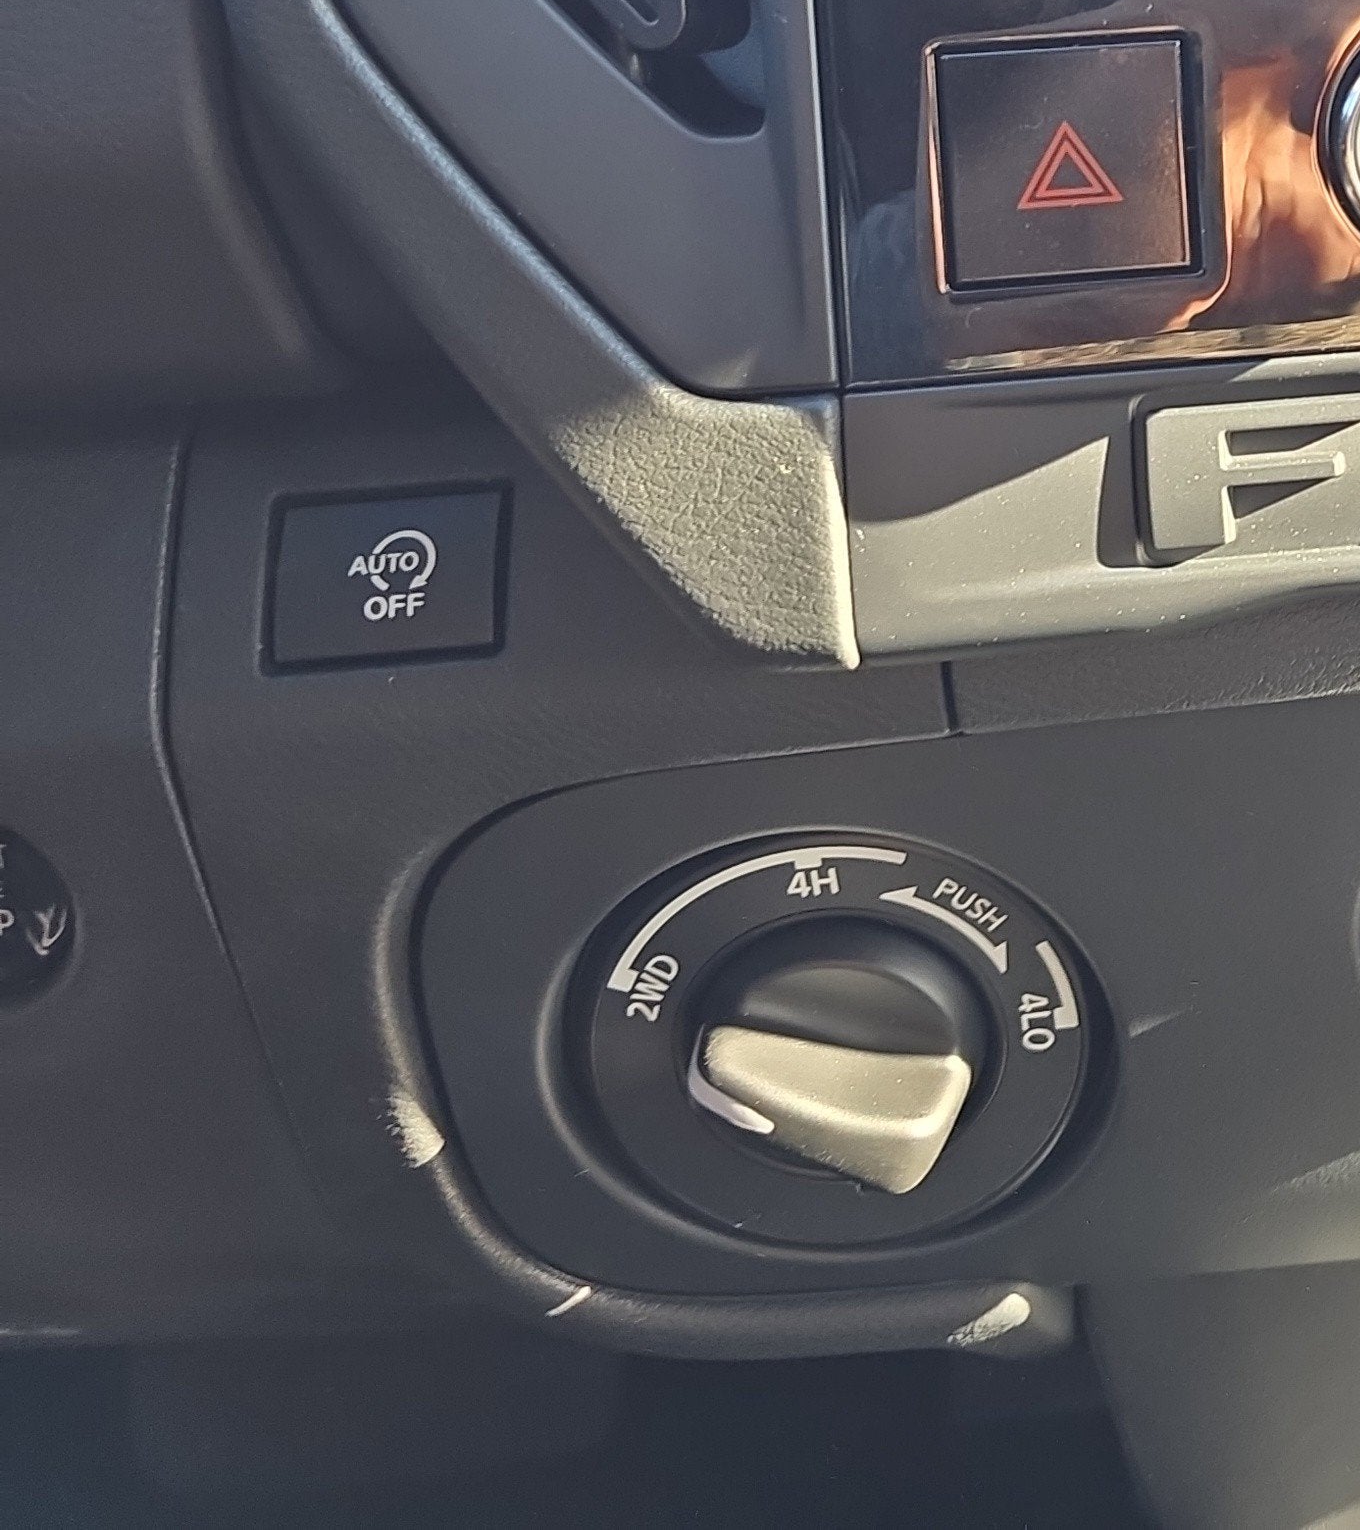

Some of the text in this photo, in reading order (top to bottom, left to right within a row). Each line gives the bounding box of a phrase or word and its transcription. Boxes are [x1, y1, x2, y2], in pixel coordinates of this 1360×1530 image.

[347, 551, 420, 577] AUTO
[363, 592, 426, 621] OFF
[786, 867, 840, 898] 4H
[931, 877, 1010, 933] PUSH
[625, 953, 680, 1023] 2WD
[1018, 992, 1056, 1053] 4LO
